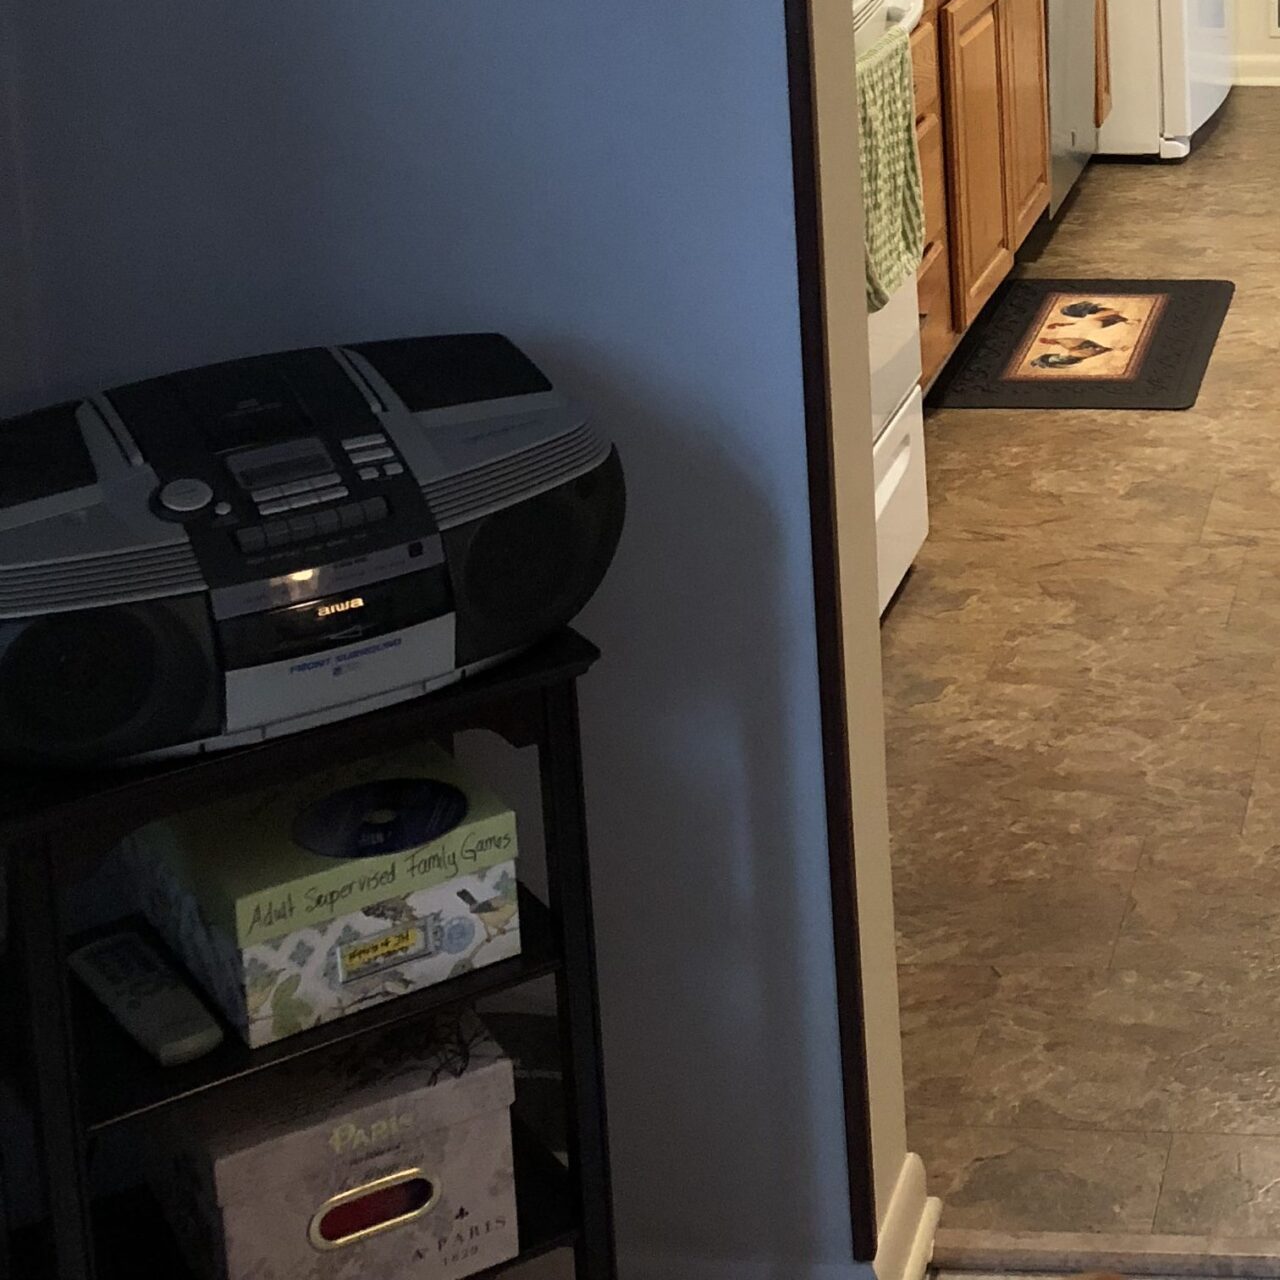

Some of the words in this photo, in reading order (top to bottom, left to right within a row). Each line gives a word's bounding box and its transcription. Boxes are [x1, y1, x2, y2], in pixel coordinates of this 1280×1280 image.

[316, 596, 366, 617] aiwa
[246, 889, 294, 937] Adult
[305, 861, 397, 918] Supervised
[406, 842, 460, 879] Family
[460, 831, 512, 861] Games
